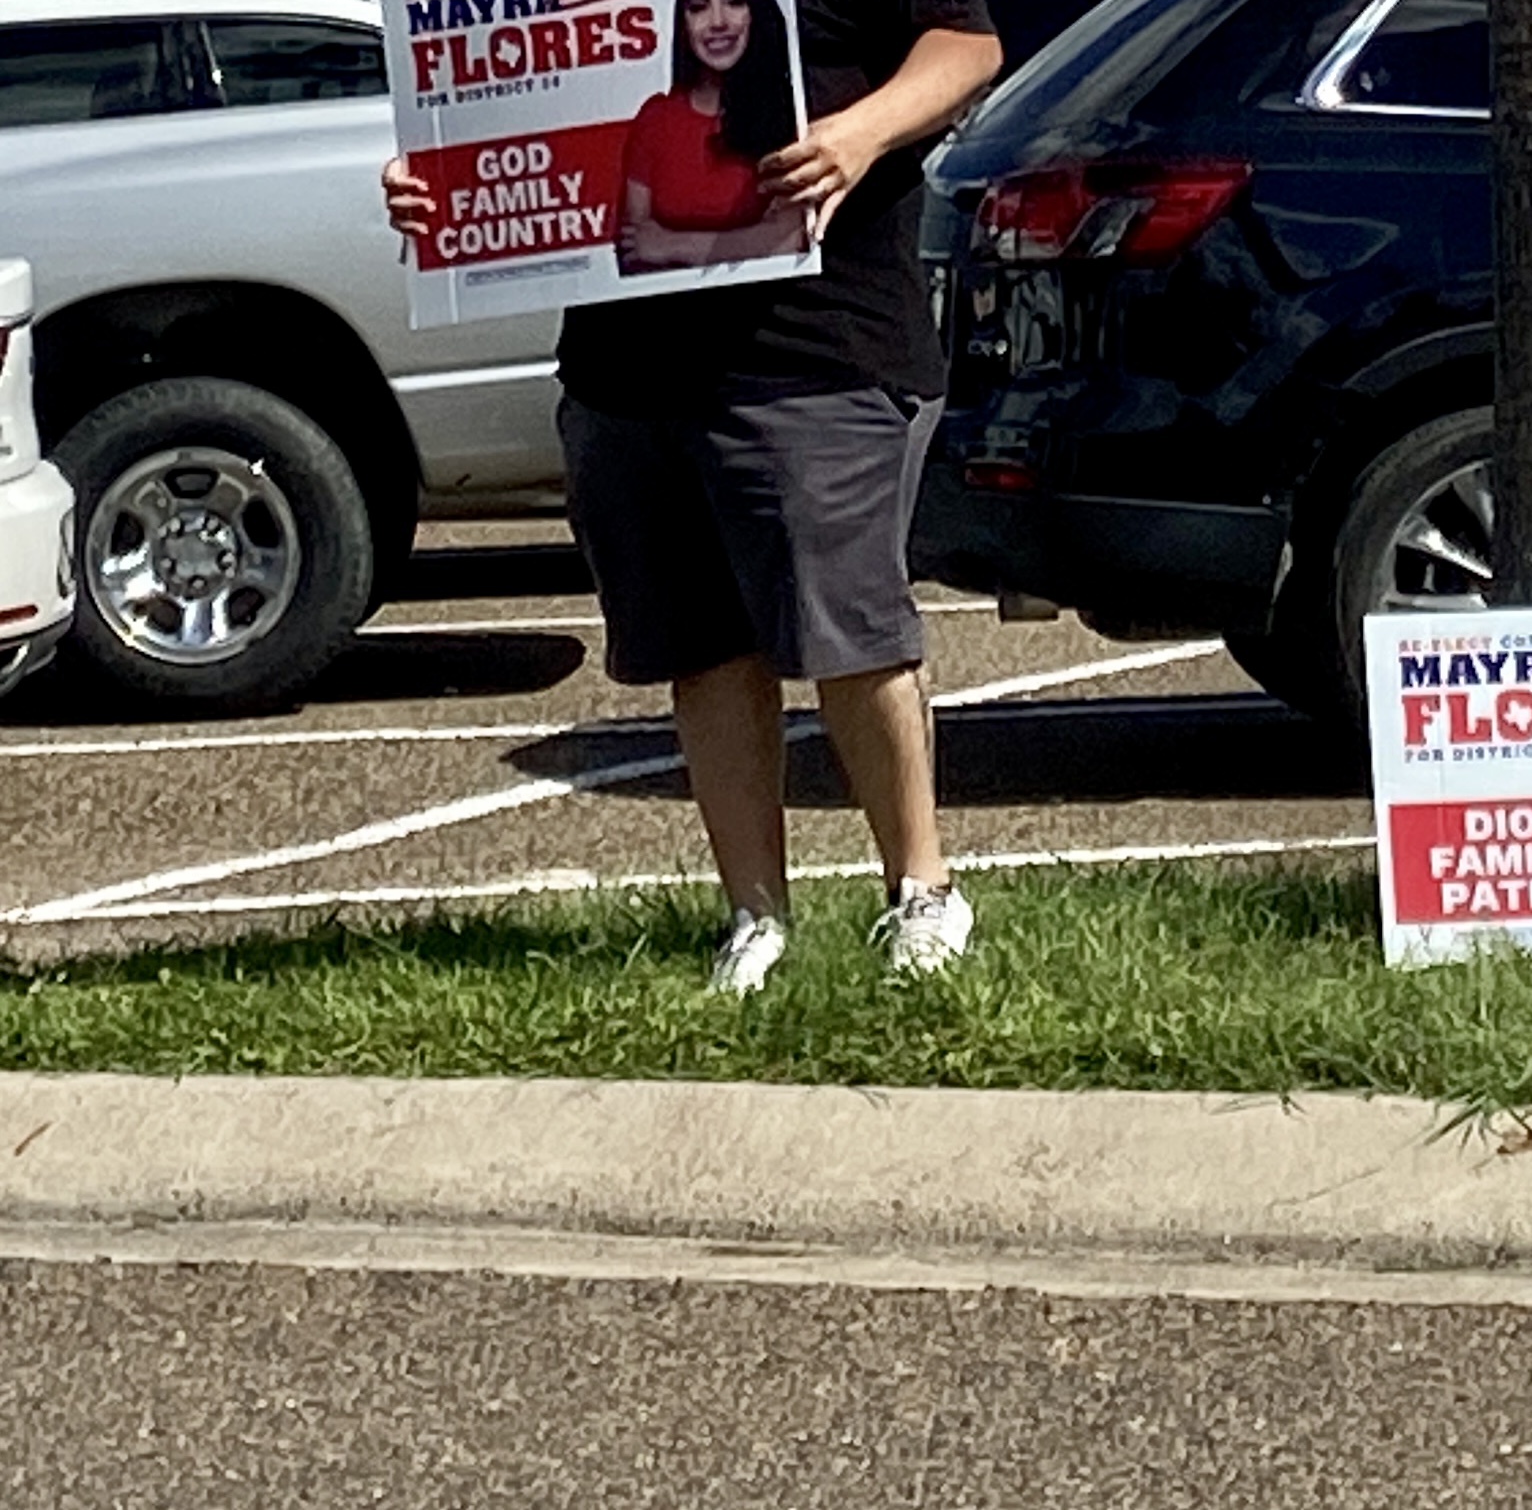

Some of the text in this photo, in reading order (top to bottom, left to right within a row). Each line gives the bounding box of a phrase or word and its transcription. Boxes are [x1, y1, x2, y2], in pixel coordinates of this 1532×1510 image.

[411, 6, 658, 93] FLORES
[416, 93, 450, 109] FOR
[455, 77, 535, 104] DISTRICT
[475, 141, 553, 181] GOD
[449, 171, 585, 222] FAMILY
[435, 204, 608, 260] COUNTRY
[1404, 747, 1444, 763] FOR
